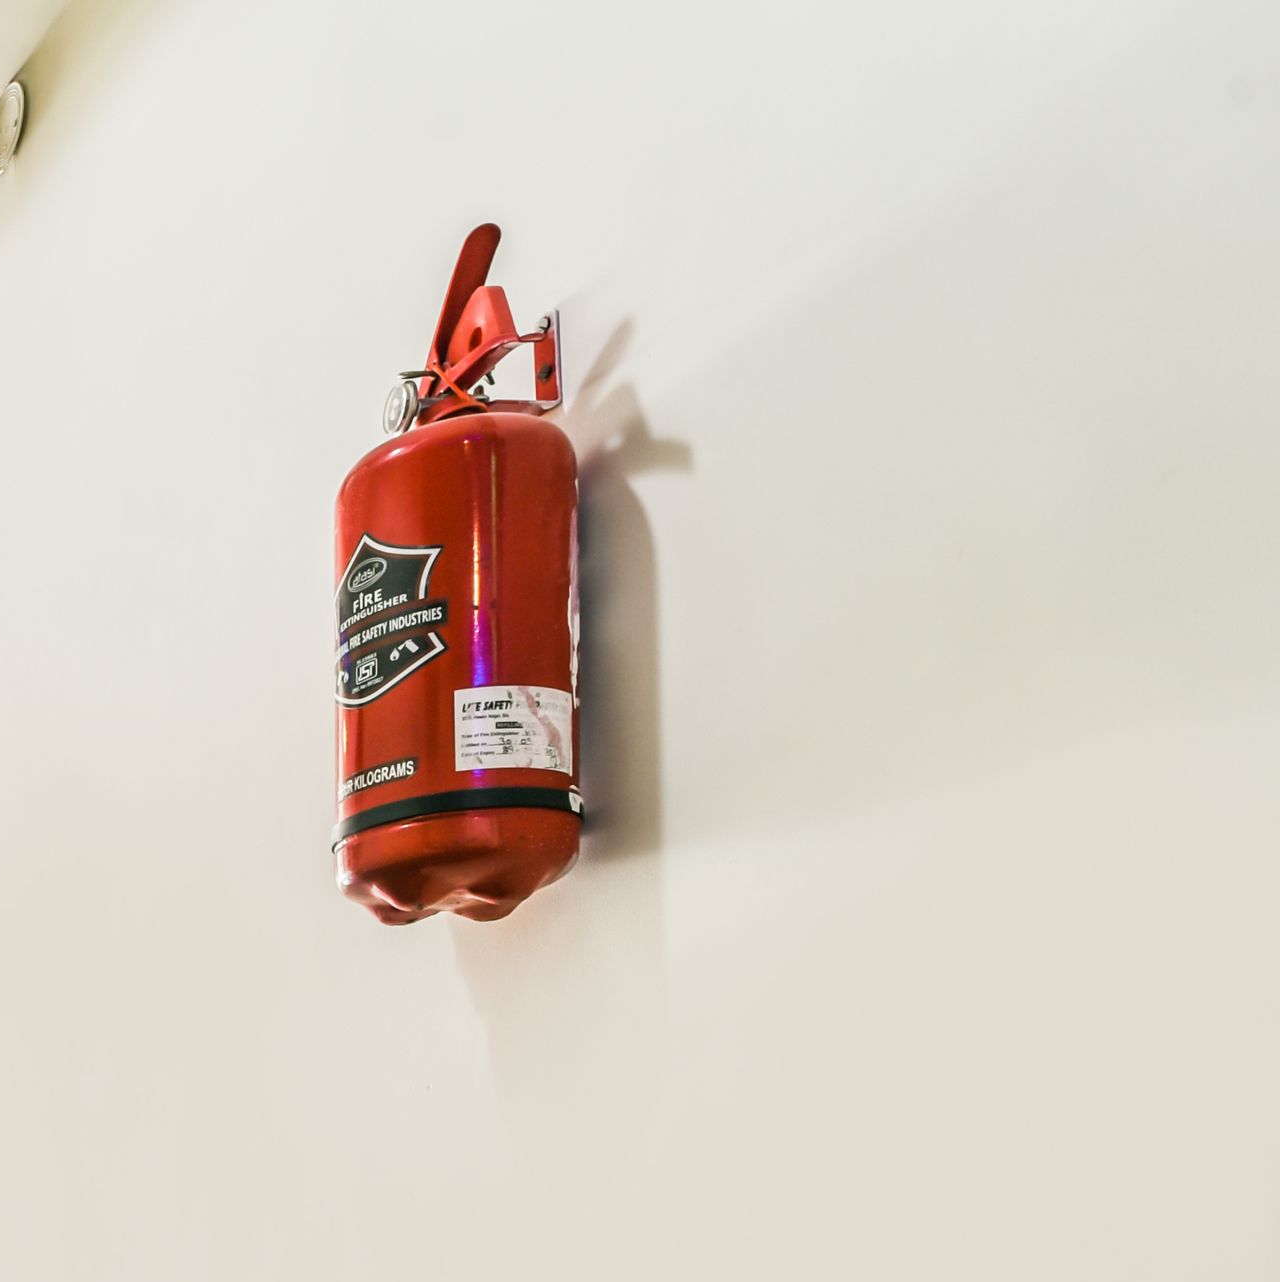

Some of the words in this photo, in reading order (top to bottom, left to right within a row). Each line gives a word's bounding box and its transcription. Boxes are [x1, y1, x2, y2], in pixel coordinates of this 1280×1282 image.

[340, 594, 408, 632] EXTINGUISHER
[352, 588, 382, 613] FIRE
[361, 621, 387, 643] SAFETY
[389, 606, 442, 632] INDUSTRIES
[354, 760, 415, 792] KILOGRAMS
